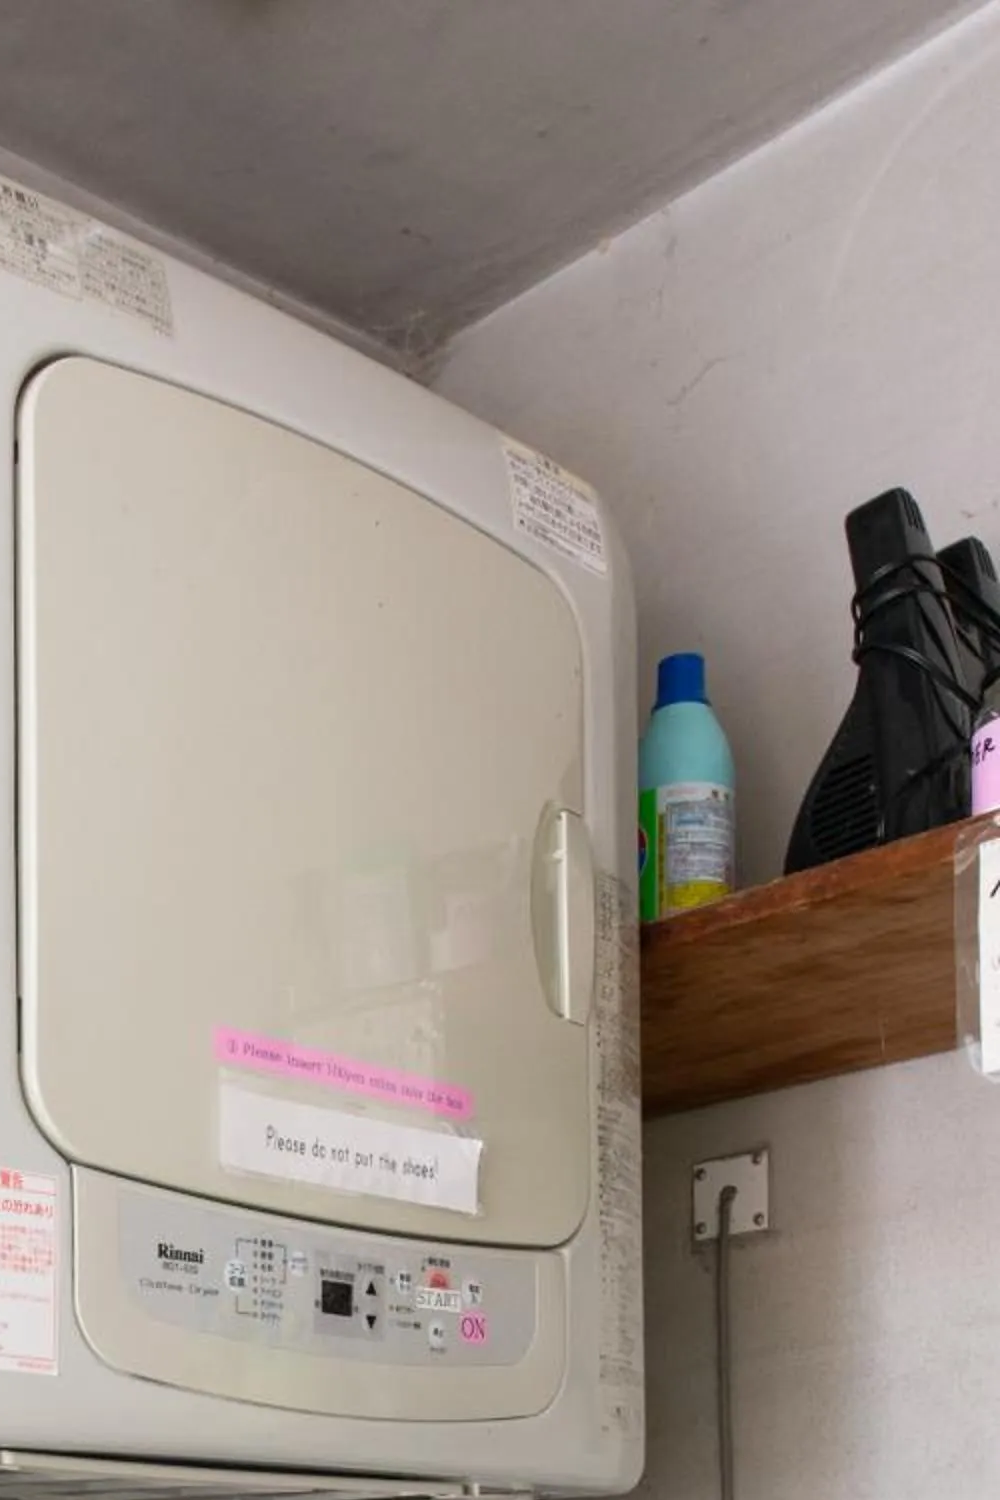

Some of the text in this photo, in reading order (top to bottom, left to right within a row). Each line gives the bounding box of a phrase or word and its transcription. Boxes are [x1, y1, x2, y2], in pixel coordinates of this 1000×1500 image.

[265, 1124, 306, 1156] Please
[311, 1137, 326, 1159] do
[331, 1147, 350, 1163] not
[354, 1152, 374, 1169] put
[379, 1155, 397, 1174] the
[157, 1242, 204, 1264] Rinnai
[417, 1292, 458, 1308] START
[461, 1317, 485, 1340] ON
